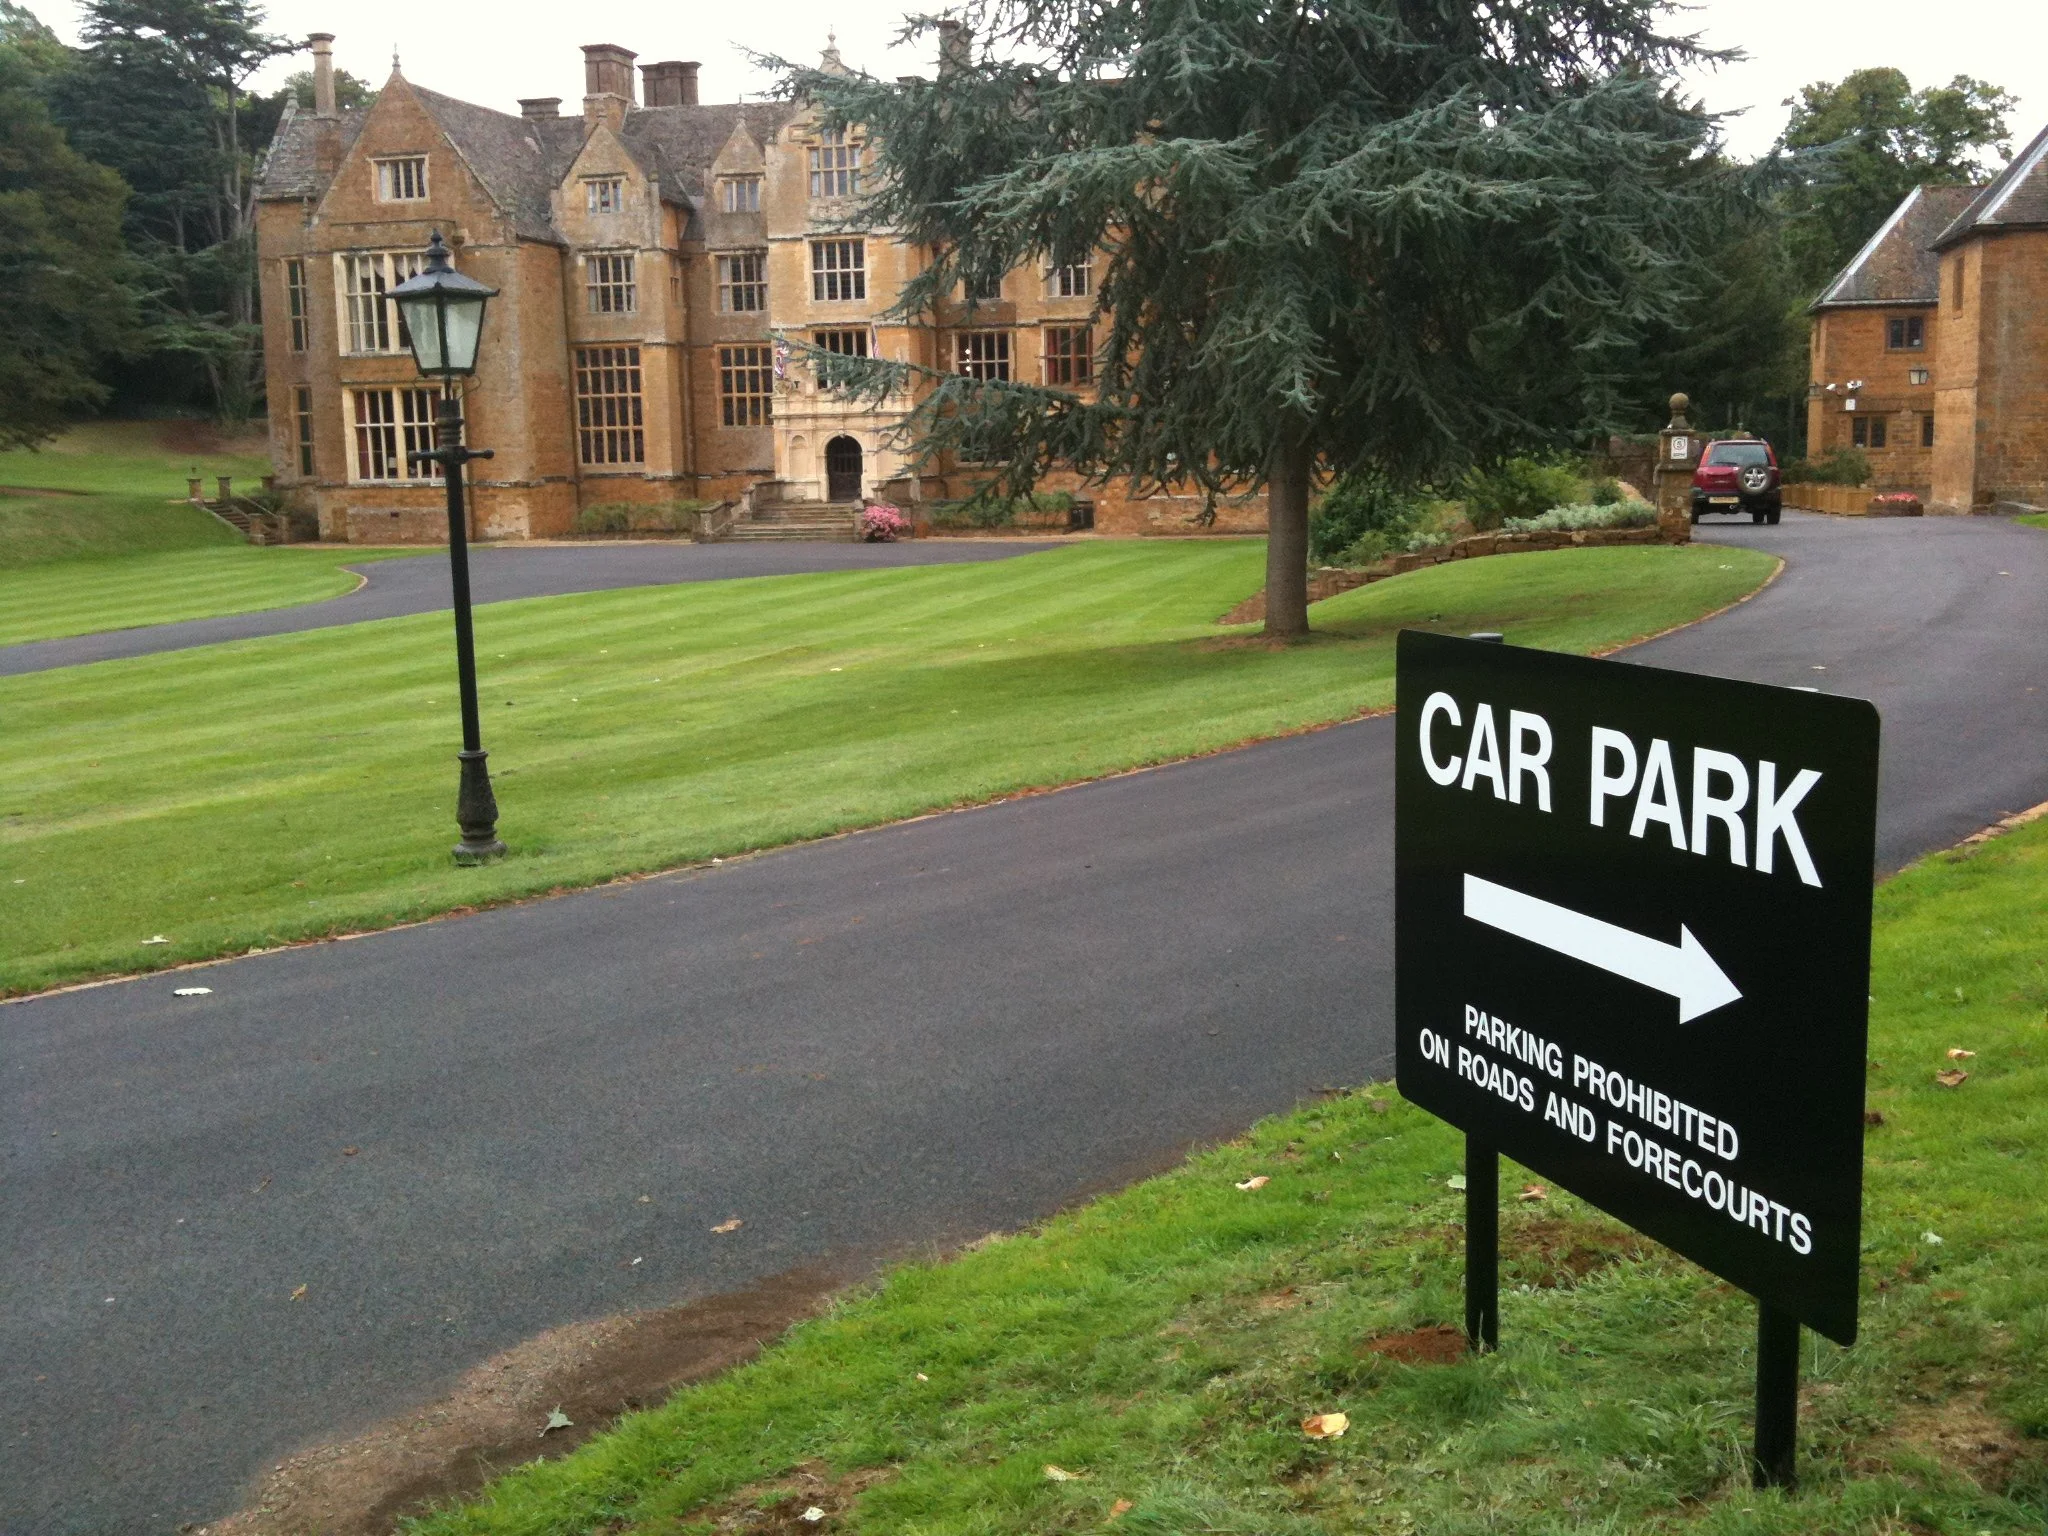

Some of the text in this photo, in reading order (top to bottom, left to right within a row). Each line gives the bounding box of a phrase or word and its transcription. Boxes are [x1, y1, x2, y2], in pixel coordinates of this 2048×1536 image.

[1419, 691, 1823, 889] CAR PARK
[1419, 1027, 1812, 1255] ON ROADS AND FORECOURTS
[1465, 1003, 1739, 1161] PARKING PROHIBITED
